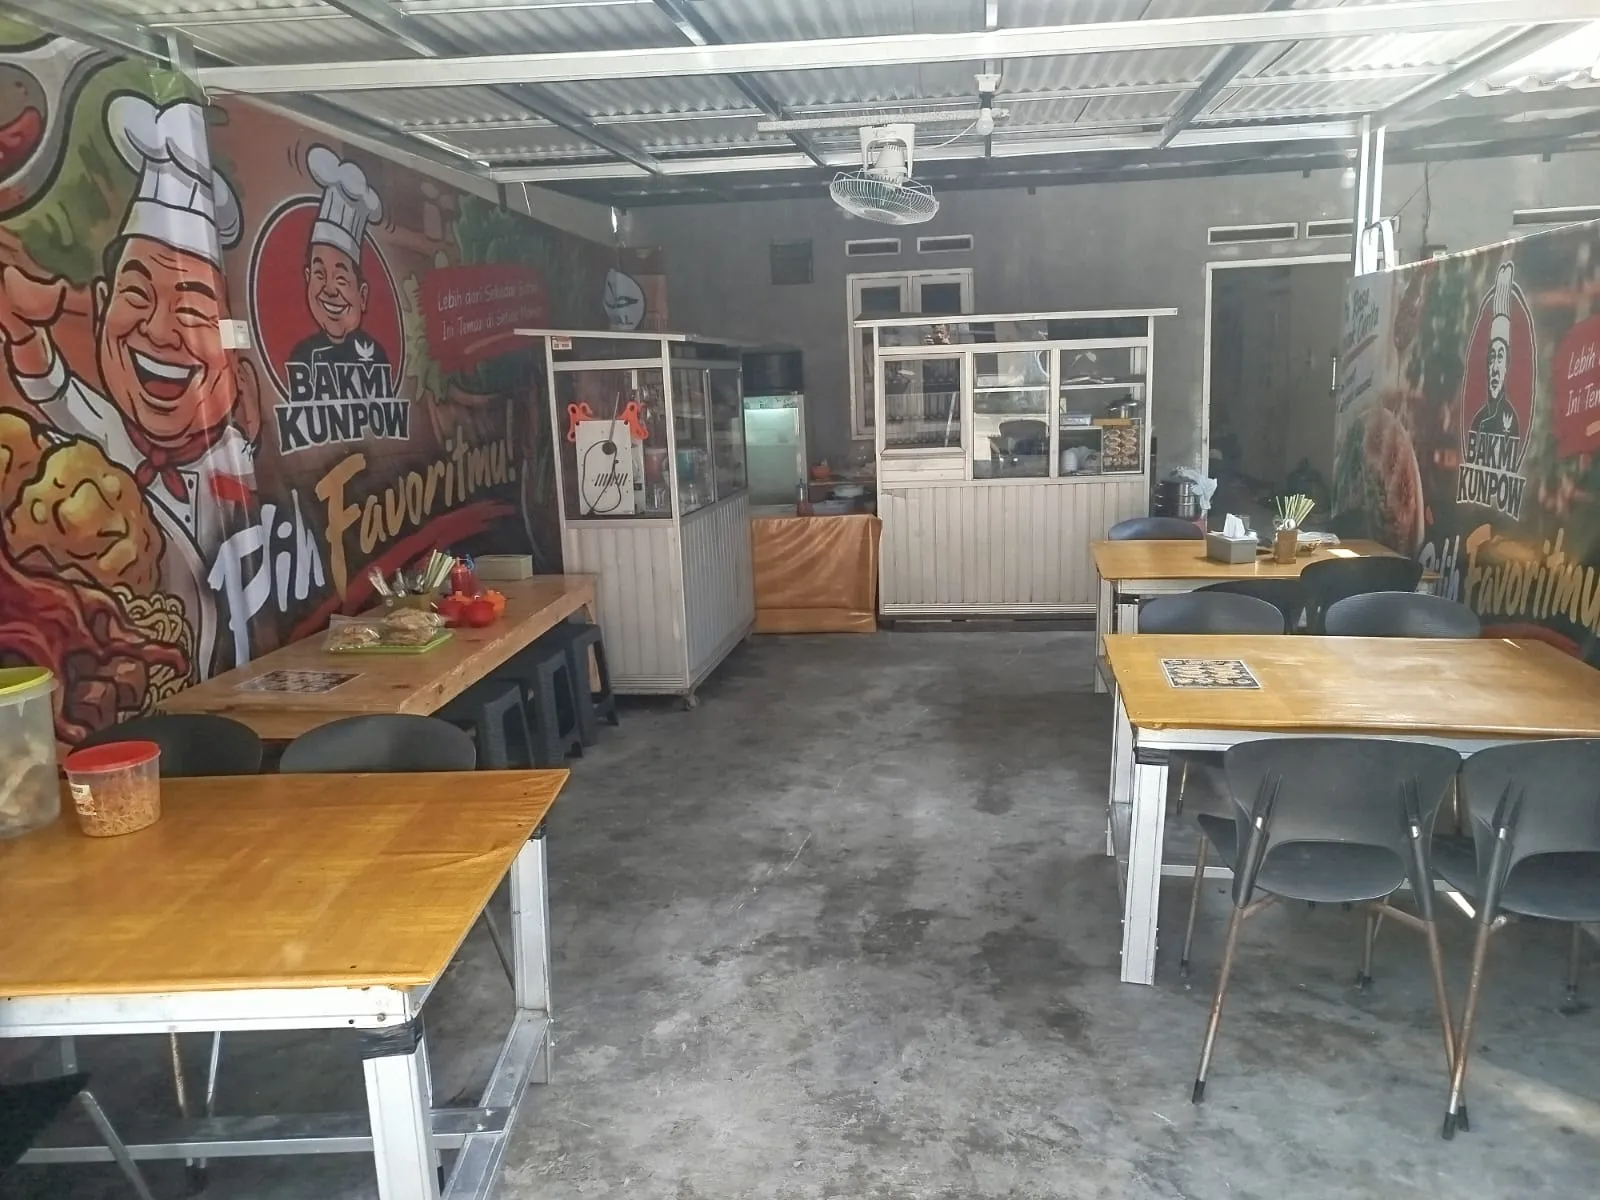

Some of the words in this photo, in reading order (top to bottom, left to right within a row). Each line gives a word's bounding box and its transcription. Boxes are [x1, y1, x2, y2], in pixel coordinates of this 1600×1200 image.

[438, 287, 462, 312] Lebih
[1567, 341, 1596, 380] Lebih
[284, 362, 395, 402] BAKMI
[1565, 387, 1582, 417] Ini
[273, 400, 411, 456] KUNPOW
[1466, 430, 1521, 475] BAKMI
[1456, 465, 1527, 521] KUNPOW
